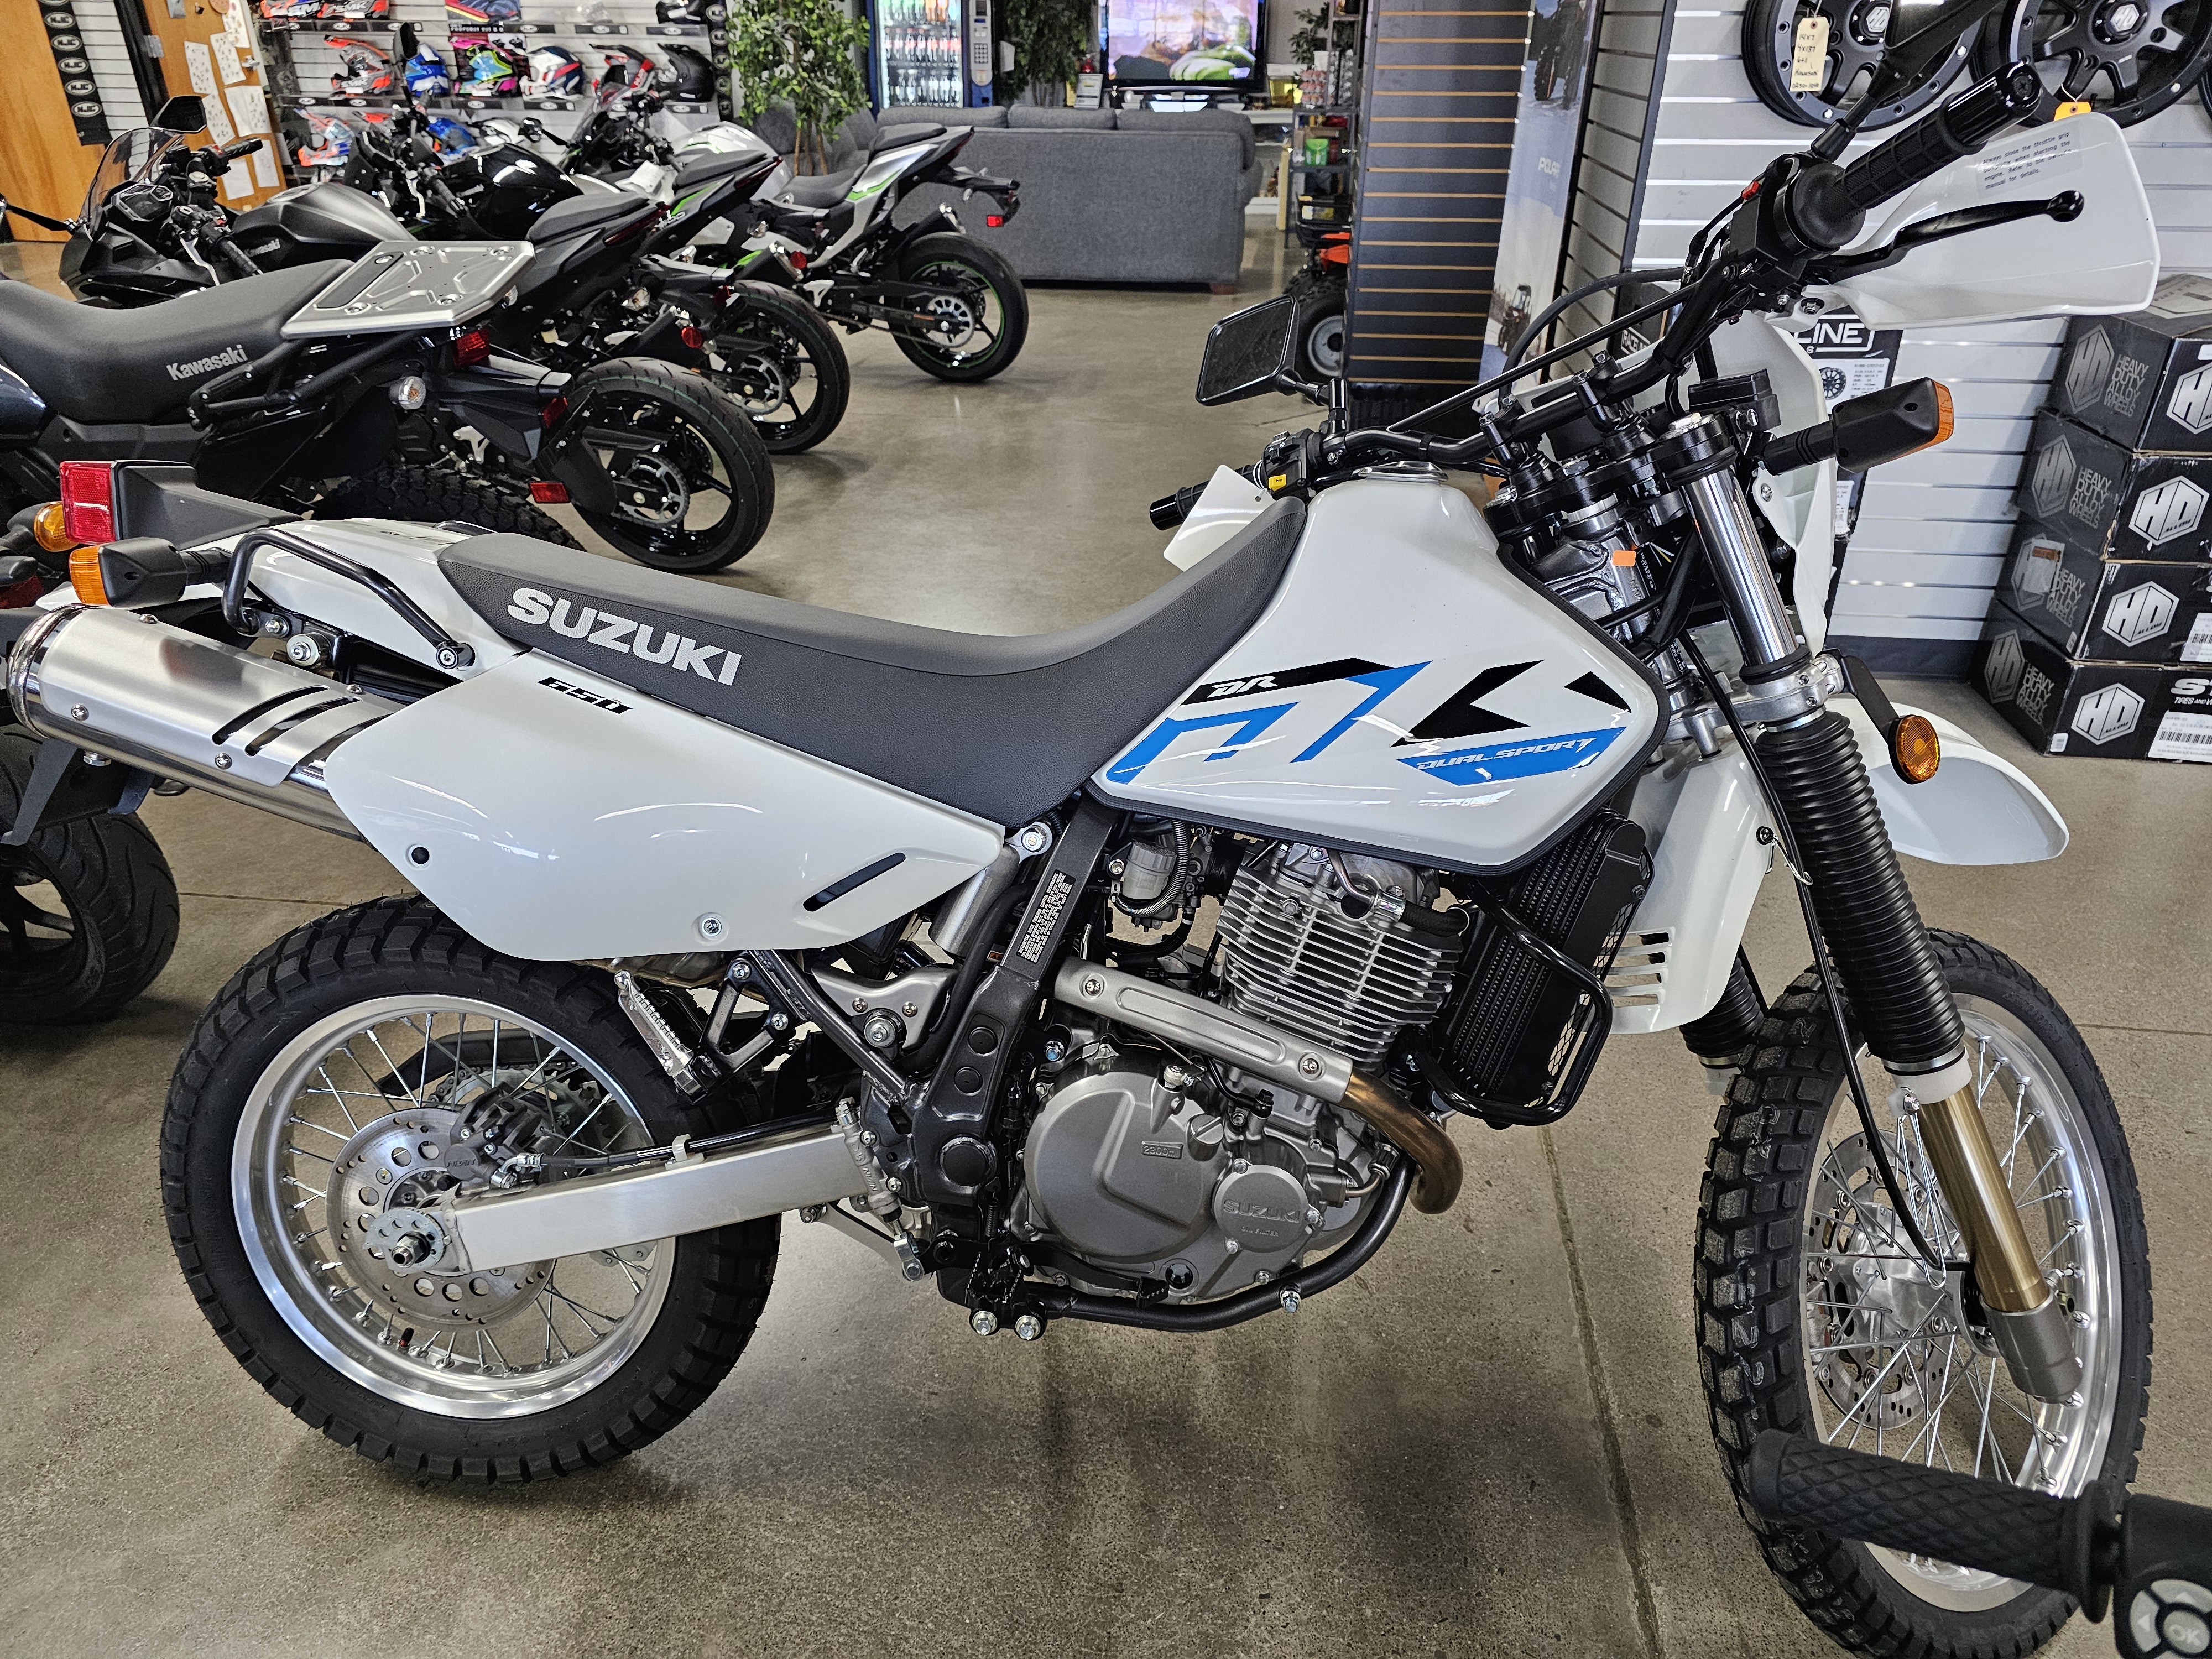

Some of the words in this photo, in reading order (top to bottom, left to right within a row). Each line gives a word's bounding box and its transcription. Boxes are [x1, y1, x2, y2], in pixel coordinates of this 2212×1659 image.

[288, 2, 320, 16] SM
[335, 2, 367, 12] SMK
[2115, 7, 2137, 28] HD
[341, 79, 368, 87] SMK
[2058, 132, 2070, 140] grip
[166, 345, 248, 381] Kawasaki
[2116, 354, 2150, 378] HEAVY
[2112, 367, 2145, 391] DUTY
[2104, 393, 2136, 417] WHEELS
[2106, 380, 2141, 405] ALLOY
[2079, 466, 2112, 492] HEAVY
[2071, 490, 2105, 517] ALLOY
[2075, 480, 2108, 504] DUTY
[2133, 479, 2205, 541] HD
[2106, 585, 2174, 643] HD
[507, 587, 742, 686] SUZUKI
[1207, 675, 1278, 698] DR
[2022, 674, 2051, 702] DUTY
[2026, 663, 2055, 692] HEAVY
[537, 677, 633, 714] 650
[2019, 685, 2048, 713] ALLOY
[2075, 687, 2140, 741] HD
[1223, 1199, 1301, 1224] SUZUKI
[2168, 1624, 2201, 1646] OK
